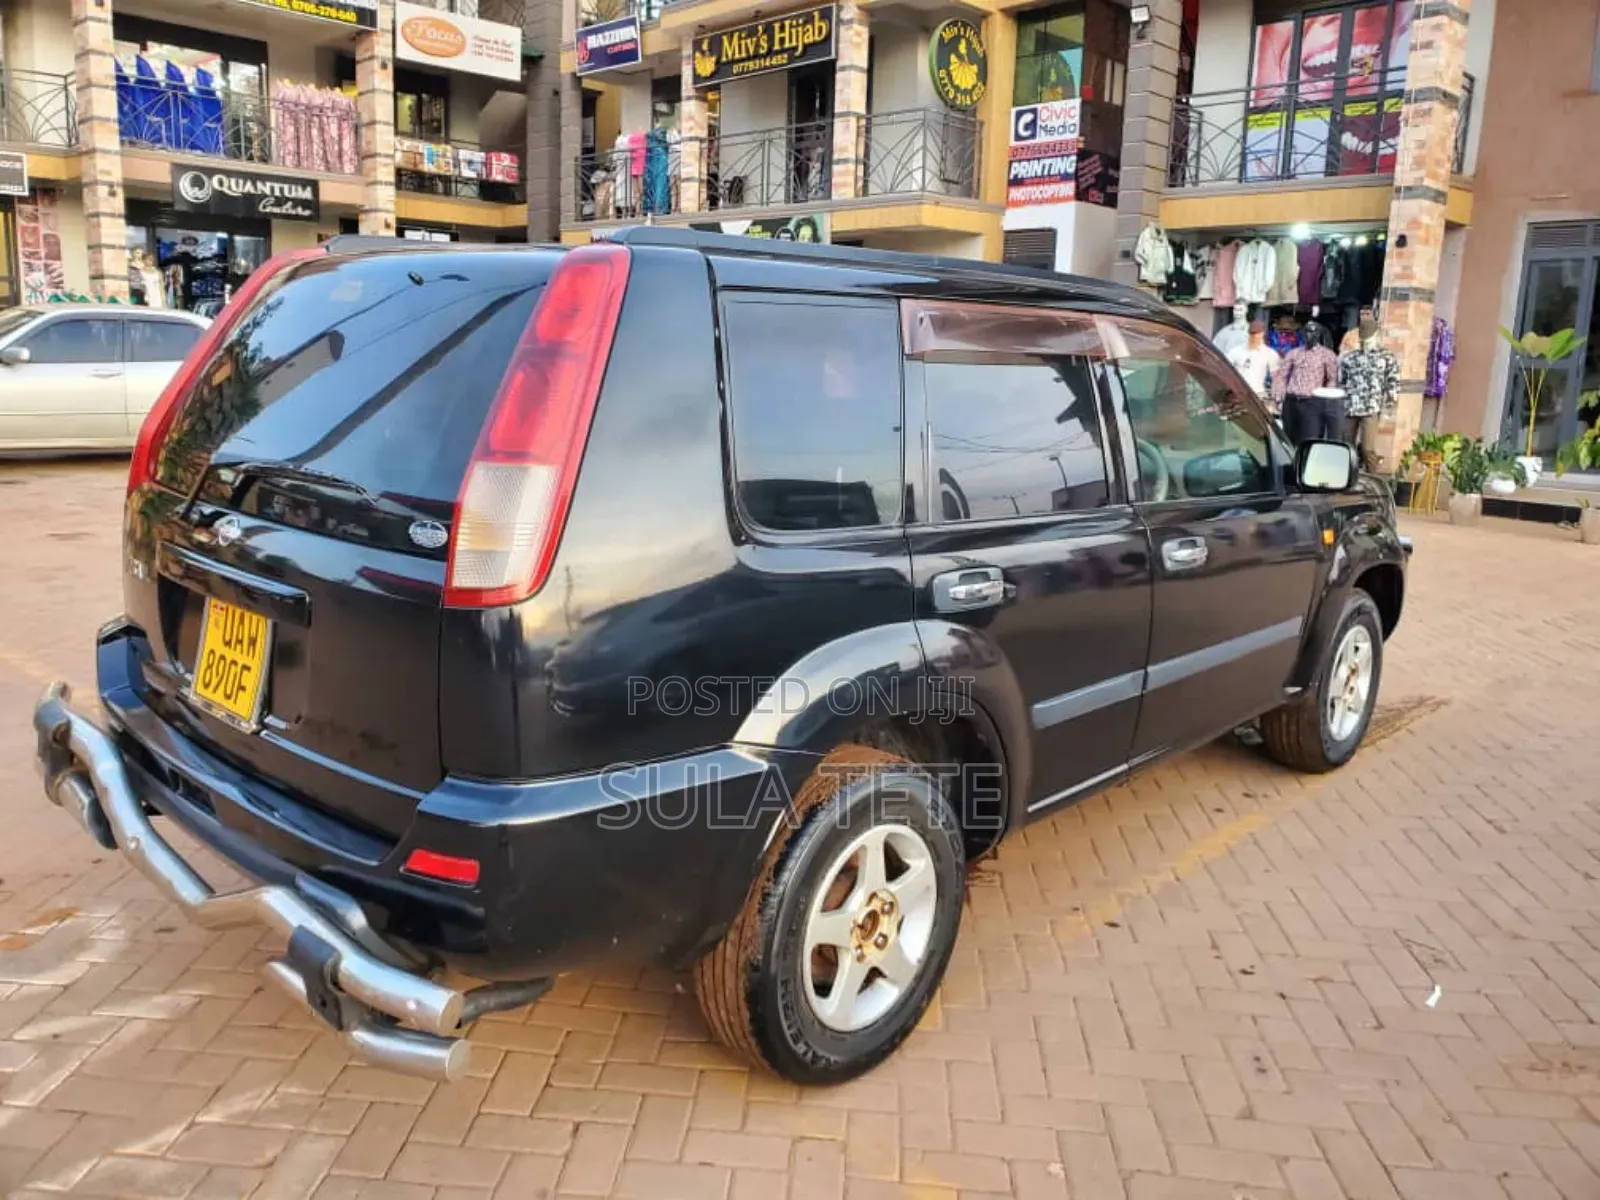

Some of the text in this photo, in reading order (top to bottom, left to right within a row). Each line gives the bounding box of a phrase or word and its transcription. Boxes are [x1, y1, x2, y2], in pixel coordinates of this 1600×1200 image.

[720, 11, 829, 62] Miv's Hijab
[1039, 104, 1077, 122] Civic
[1039, 122, 1077, 137] Media
[1010, 155, 1077, 179] PRINTING
[212, 174, 313, 199] QUANTUM
[222, 605, 260, 660] UAW
[202, 648, 251, 705] 890F
